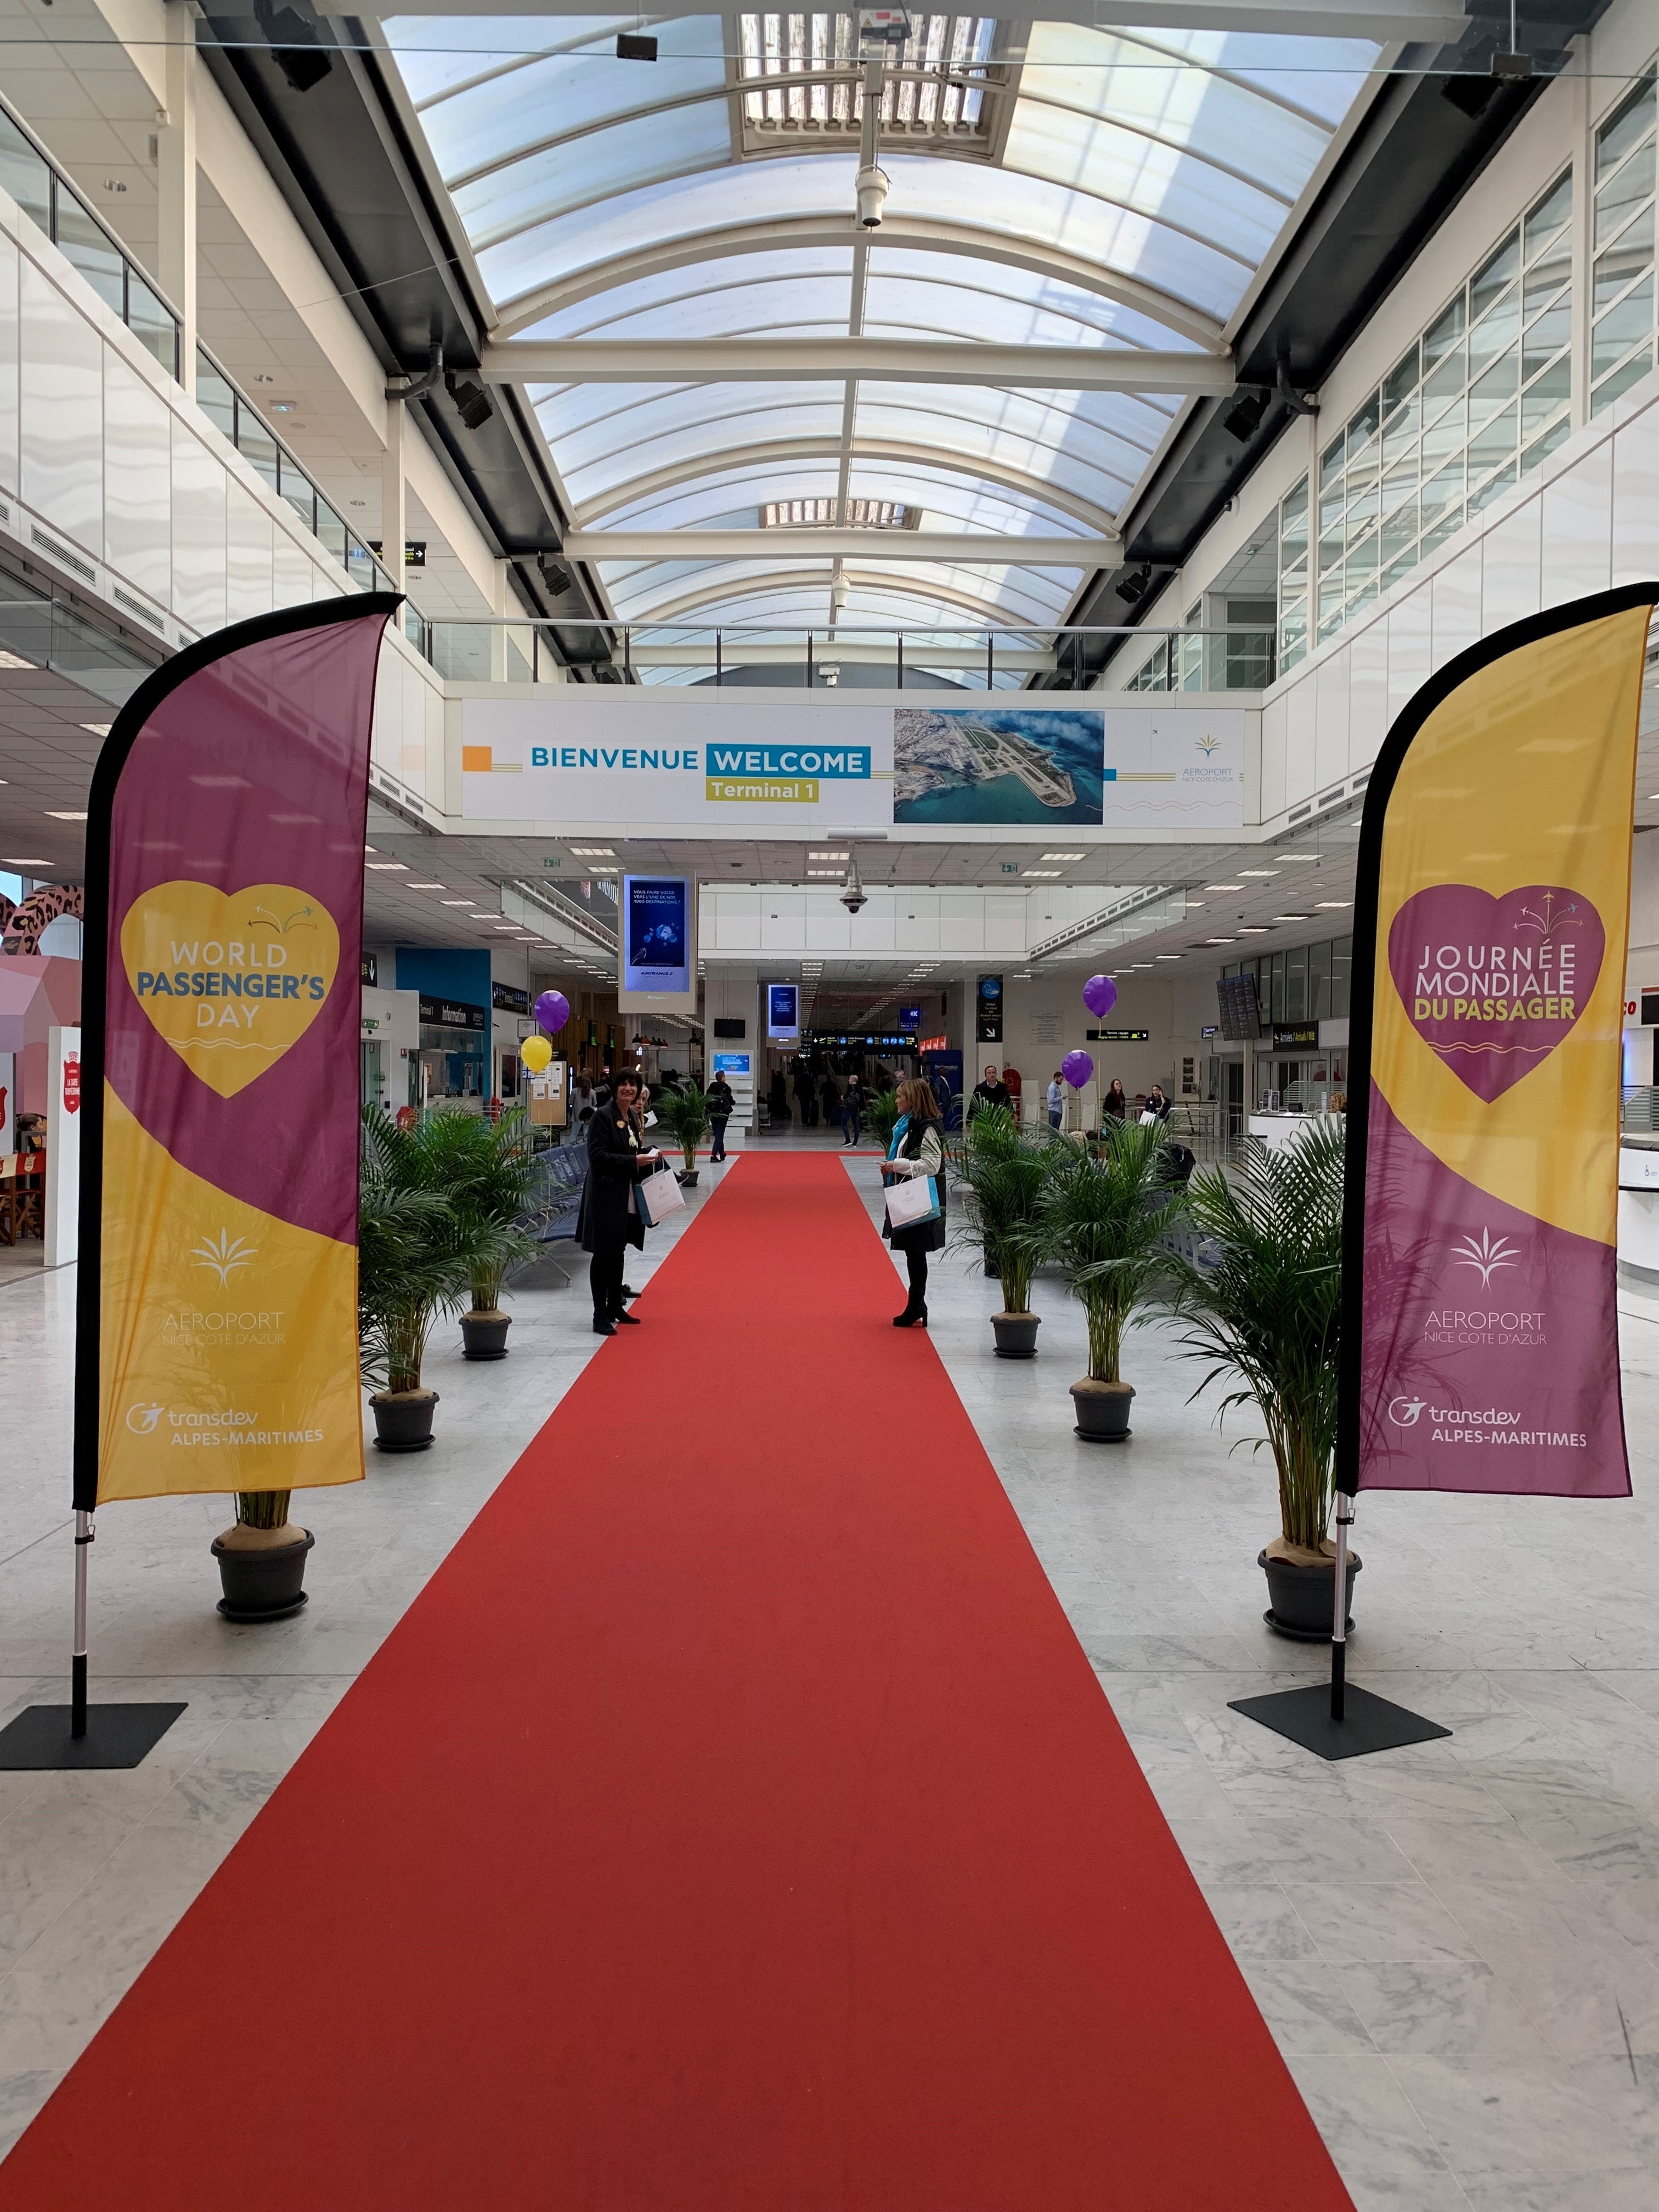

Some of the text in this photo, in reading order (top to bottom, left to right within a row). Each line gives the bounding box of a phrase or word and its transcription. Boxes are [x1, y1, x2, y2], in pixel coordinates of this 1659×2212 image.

[531, 747, 864, 773] BIENVENUE WELCOME
[711, 781, 813, 799] Terminal 1
[170, 941, 287, 968] WORLD
[1418, 938, 1576, 970] JOURNÉE
[137, 972, 325, 1001] PASSENGER'S
[1415, 971, 1575, 997] MONDIALE
[196, 1003, 260, 1028] DAY
[442, 1005, 466, 1024] Information
[1414, 998, 1576, 1021] DU PASSAGER
[164, 1312, 284, 1331] AEROPORT
[1425, 1311, 1546, 1330] AEROPORT
[162, 1334, 191, 1346] NICE
[235, 1333, 286, 1345] D'AZUR
[1424, 1331, 1454, 1343] NICE
[1498, 1333, 1548, 1345] D'AZUR
[167, 1408, 258, 1426] transdev
[1428, 1406, 1521, 1425] transdev
[171, 1429, 324, 1446] ALPES-MARITIMES
[1431, 1429, 1587, 1447] ALPES-MARITIMES
